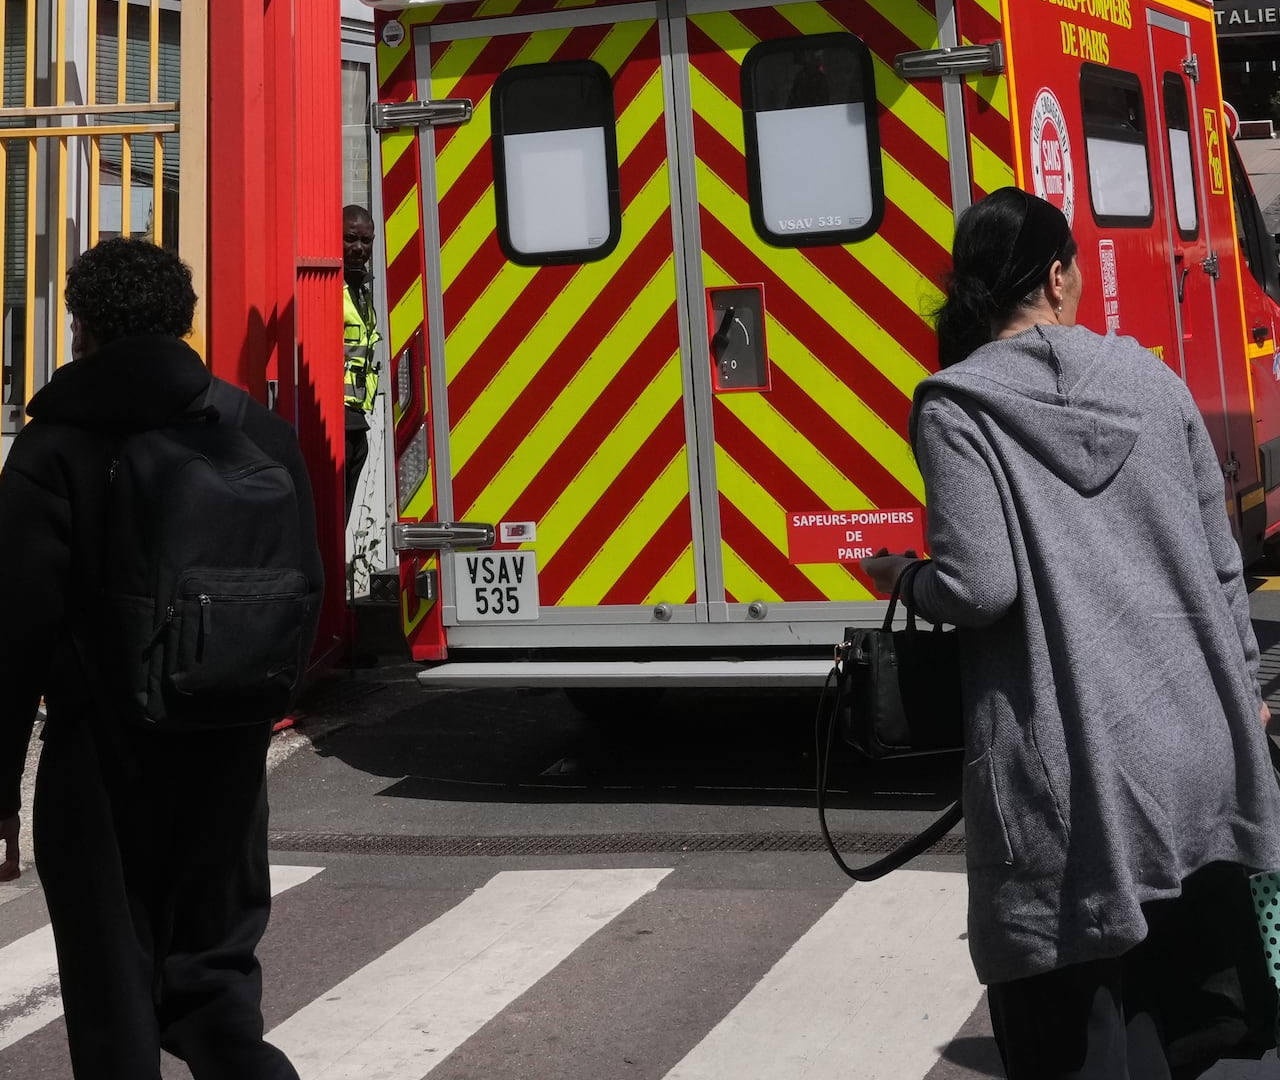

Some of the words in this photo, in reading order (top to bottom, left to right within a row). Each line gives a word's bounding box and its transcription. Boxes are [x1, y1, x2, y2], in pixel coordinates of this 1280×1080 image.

[1060, 21, 1078, 57] DE
[1078, 26, 1109, 65] PARIS
[1042, 140, 1061, 171] SANS
[779, 218, 813, 230] VSAV
[818, 216, 842, 227] 535
[793, 512, 914, 527] SAPEURS-POMPIERS
[846, 531, 862, 542] DE
[838, 547, 873, 559] PARIS
[466, 556, 524, 584] VSAV
[475, 587, 519, 614] 535
